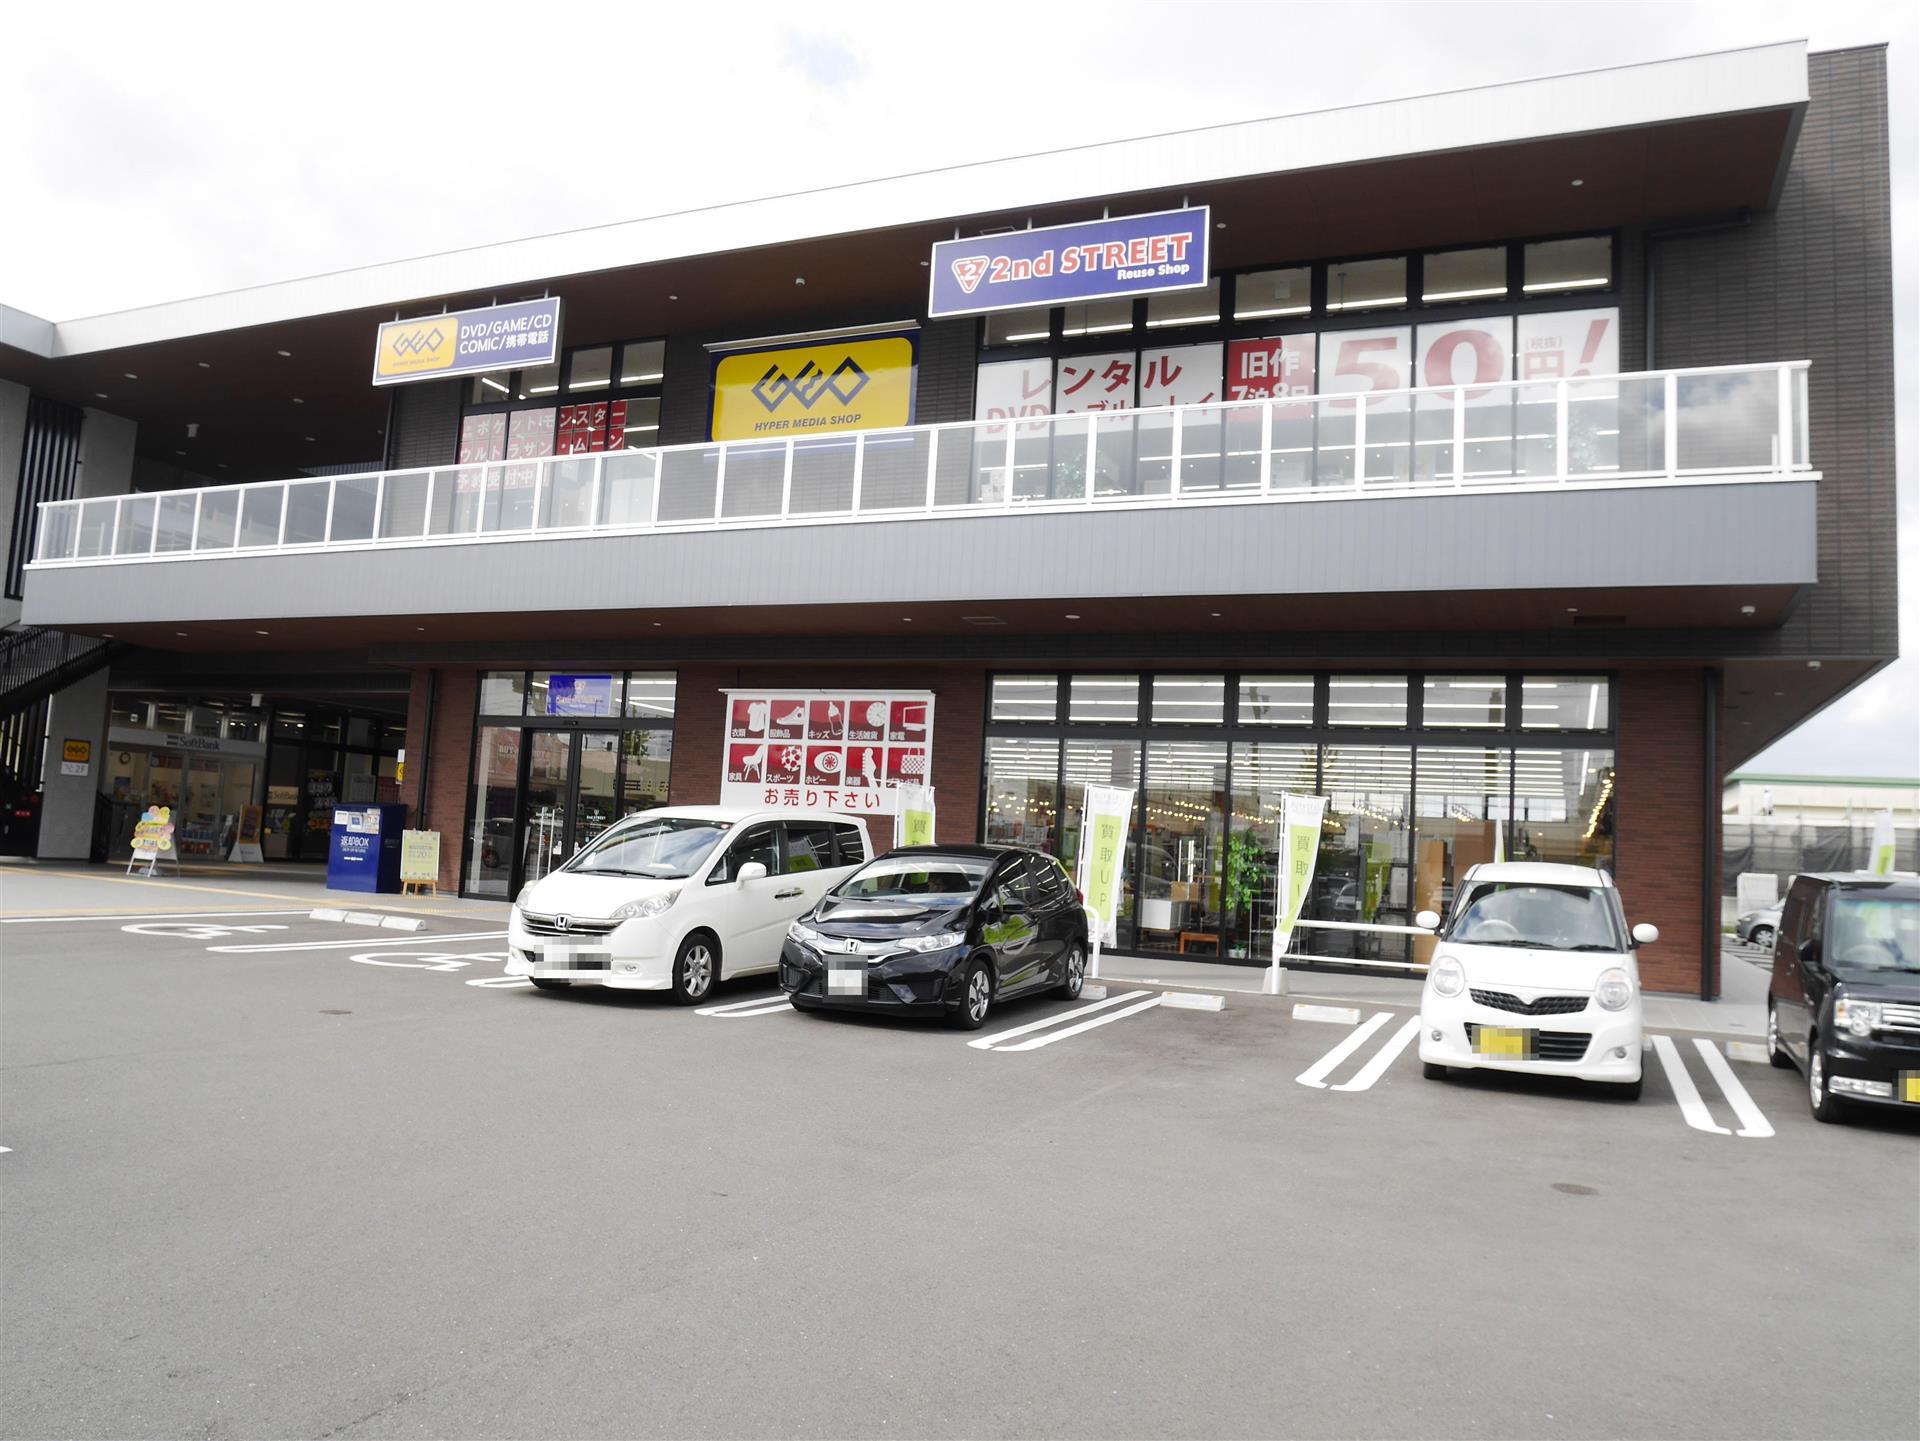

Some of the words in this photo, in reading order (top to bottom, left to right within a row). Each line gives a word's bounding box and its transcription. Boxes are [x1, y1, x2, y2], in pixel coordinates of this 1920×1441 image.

[989, 250, 1054, 283] 2nd
[1060, 232, 1192, 274] STREET
[1117, 268, 1155, 280] Reuse
[1157, 263, 1190, 277] Shop
[460, 313, 552, 340] DVD/GAME/CD
[459, 330, 550, 355] COMIC/携帯電話
[1241, 348, 1300, 380] 旧作
[1022, 355, 1182, 400] レンタル
[754, 419, 789, 431] HYPER
[792, 417, 827, 428] MEDIA
[830, 413, 862, 425] SHOP
[180, 735, 220, 750] SoftBank
[808, 730, 830, 740] キッズ
[766, 774, 795, 784] スポーツ
[805, 775, 828, 785] ホビー
[764, 788, 880, 807] お売り下さい
